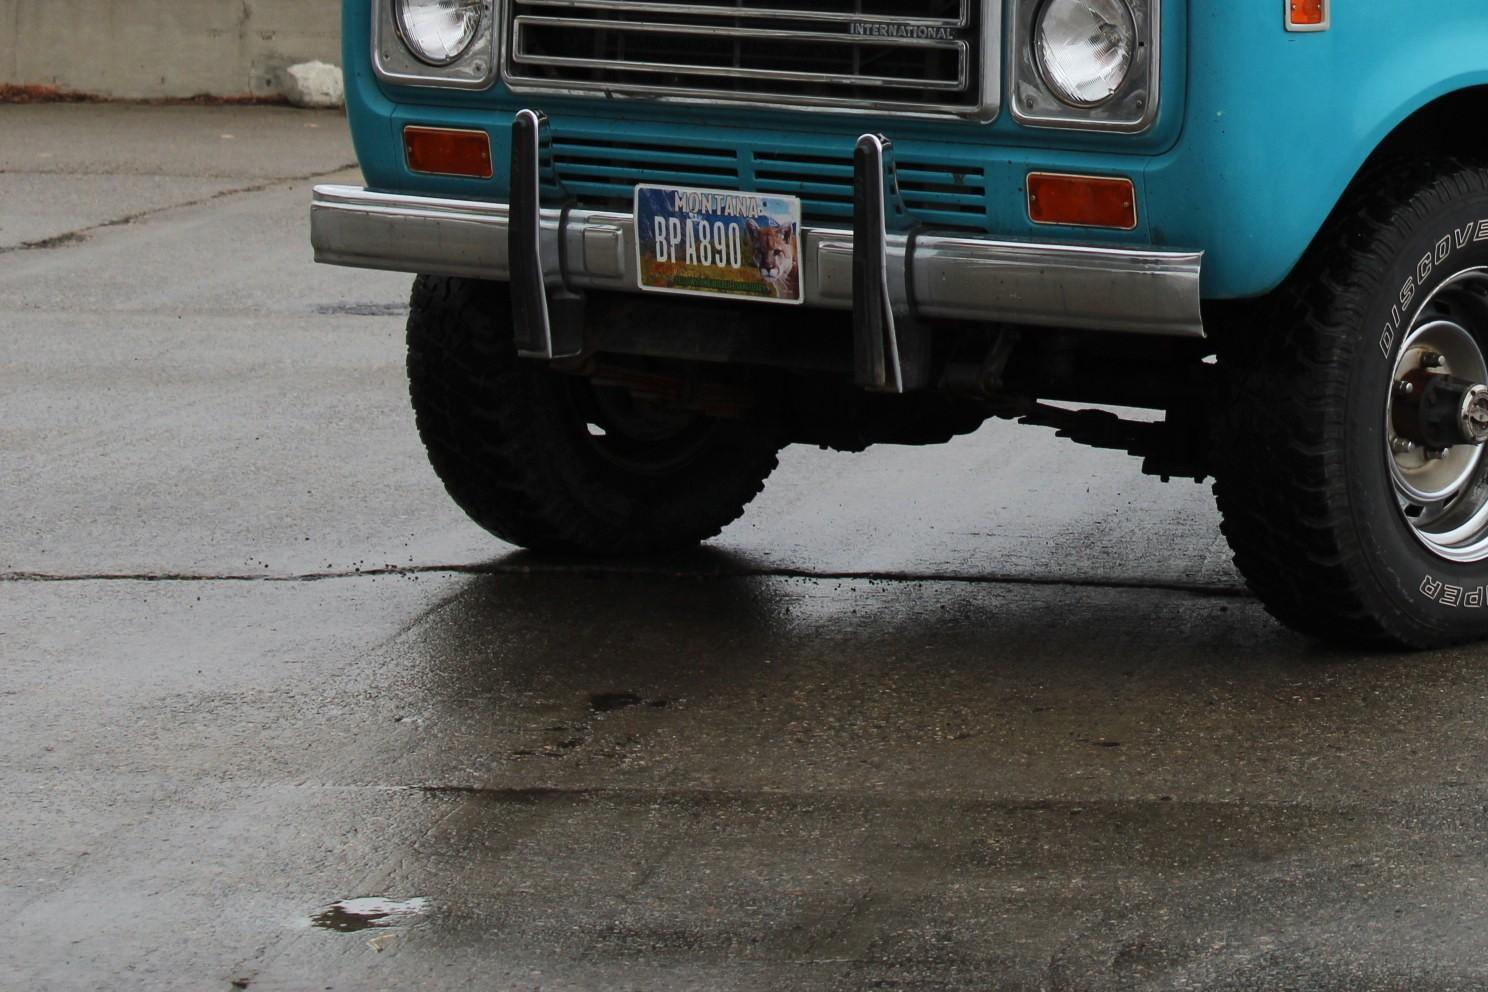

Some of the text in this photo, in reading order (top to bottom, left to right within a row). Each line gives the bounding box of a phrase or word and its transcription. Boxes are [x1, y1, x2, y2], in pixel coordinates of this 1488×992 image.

[850, 22, 954, 40] INTERNATIONAL
[674, 191, 759, 218] MONTANA
[654, 215, 742, 269] BPA890
